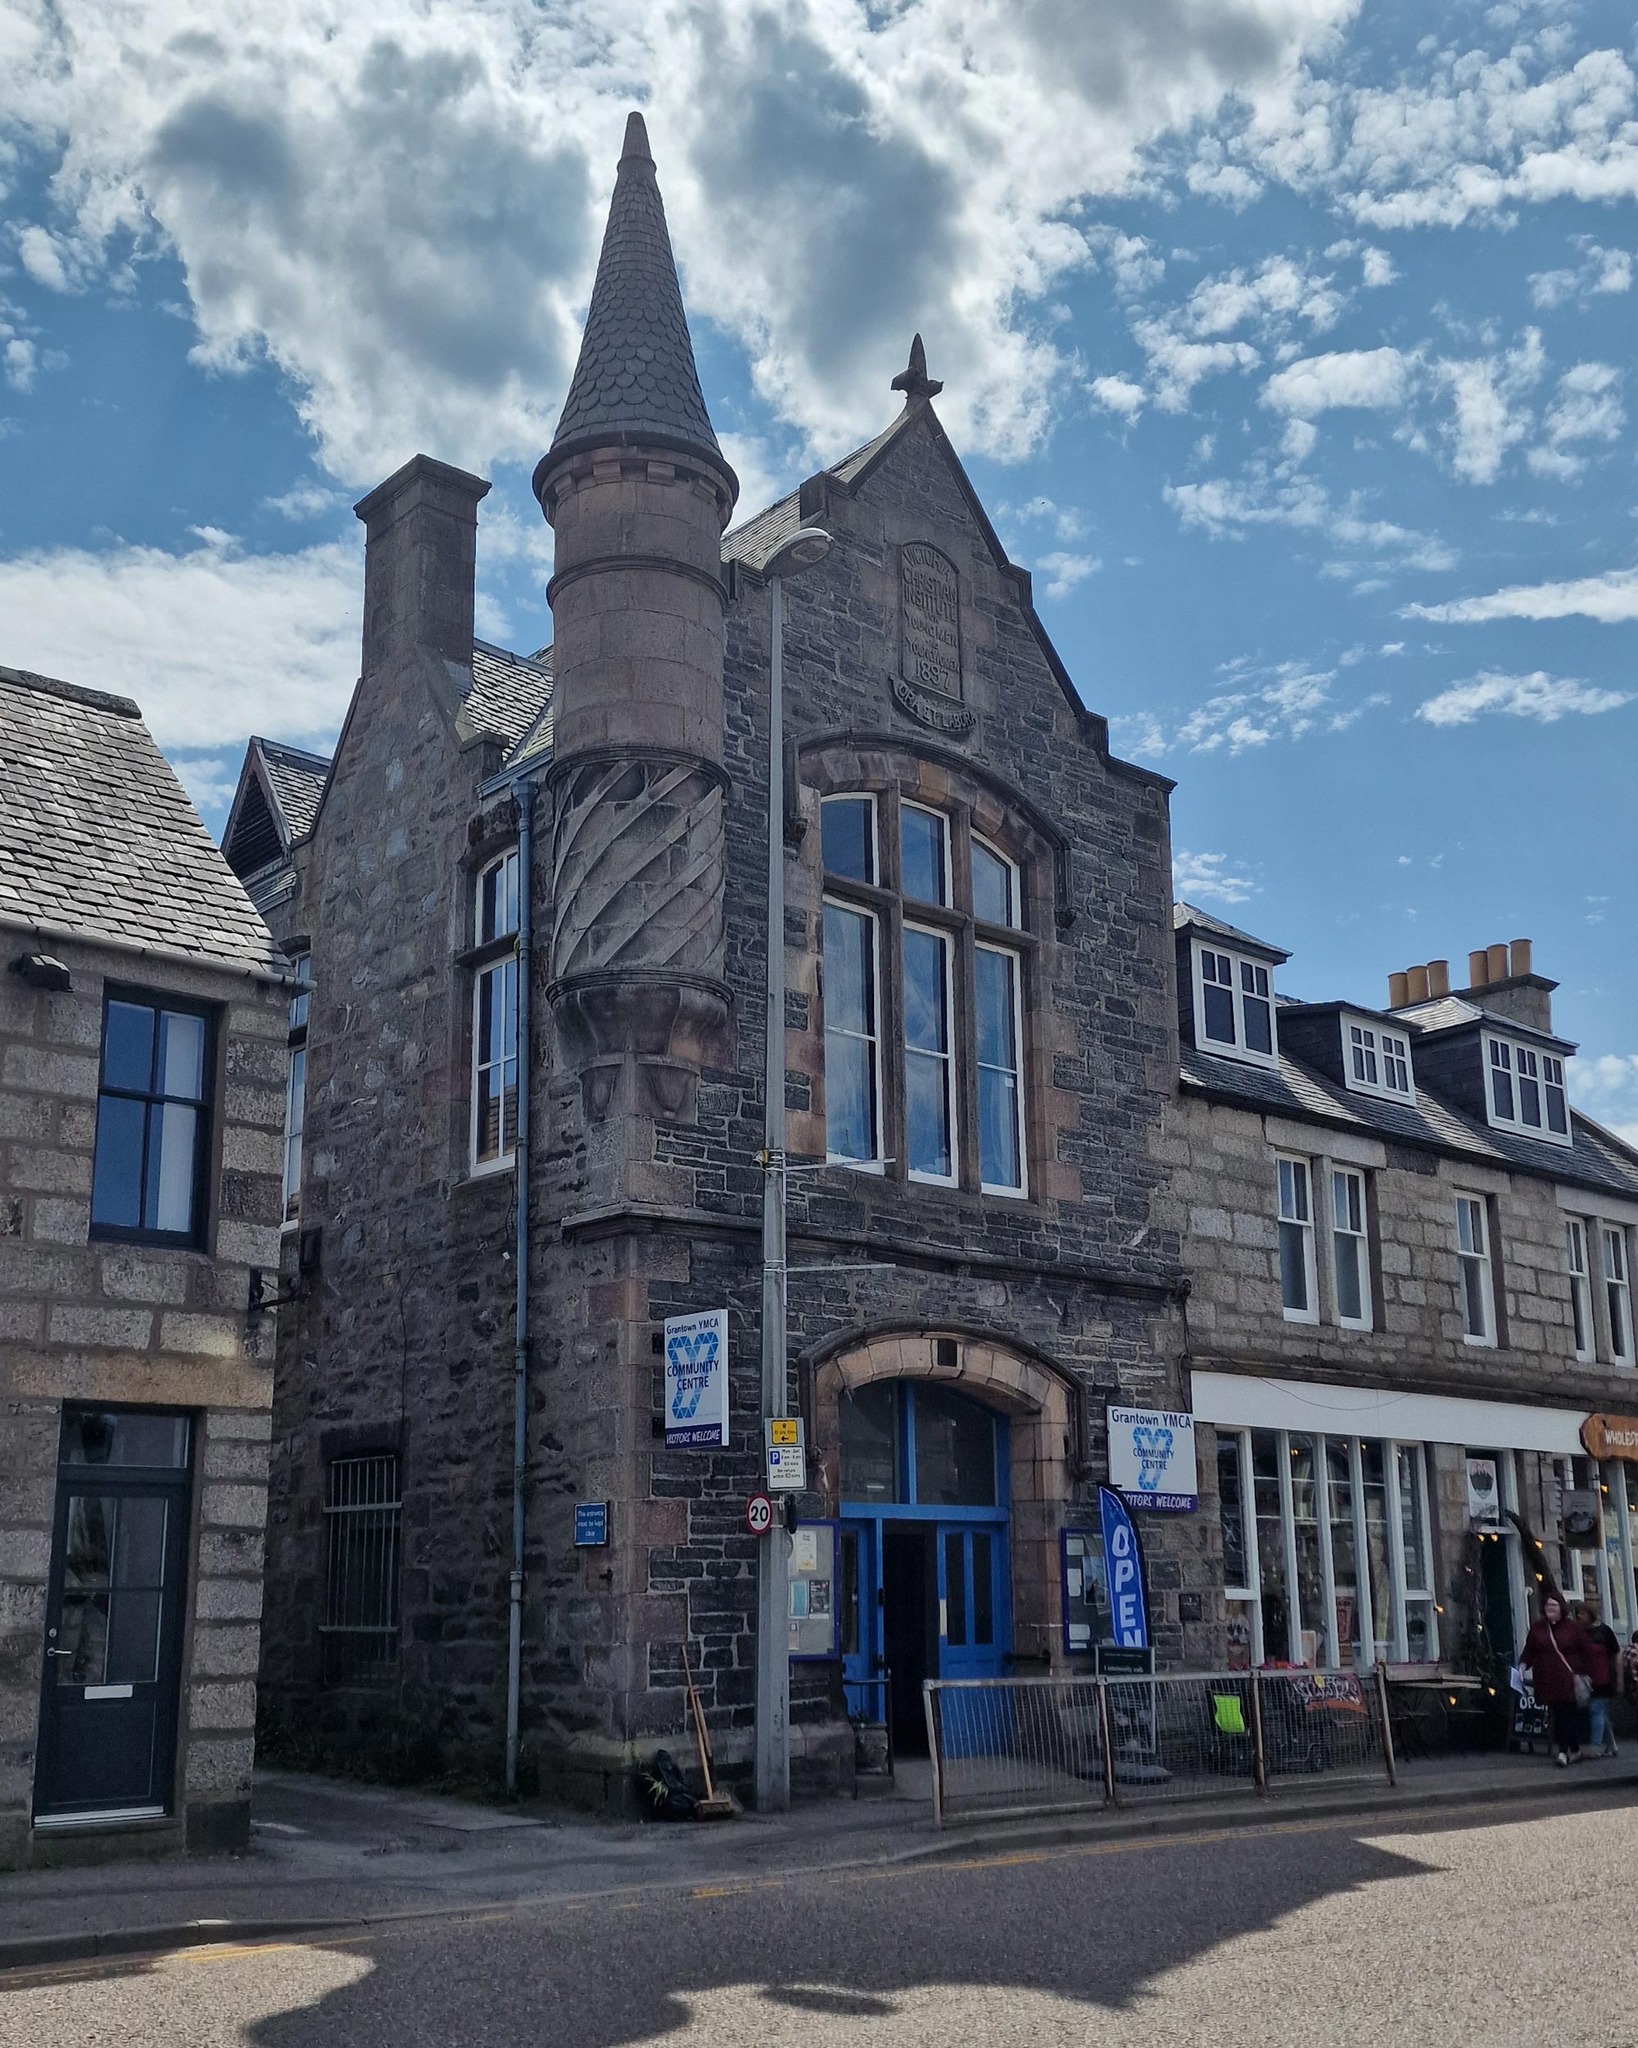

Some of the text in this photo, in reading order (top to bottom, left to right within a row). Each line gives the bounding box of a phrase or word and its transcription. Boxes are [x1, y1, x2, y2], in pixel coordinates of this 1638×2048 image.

[902, 546, 949, 582] VICTORIA
[903, 567, 958, 604] CHRISTIAN
[904, 583, 958, 623] INSTITUTE
[916, 658, 949, 690] 1897
[899, 684, 977, 729] ORA ET LABORA
[666, 1317, 719, 1335] Grantown YMCA
[667, 1359, 720, 1378] COMMUNITY
[676, 1375, 710, 1391] CENTRE
[1111, 1408, 1193, 1430] Grantown YMCA
[666, 1429, 721, 1445] VISITORS WELCOME
[1133, 1447, 1175, 1460] COMMUNITY
[1141, 1460, 1168, 1470] CENTRE
[1155, 1496, 1192, 1509] WELCOME
[750, 1505, 769, 1522] 20
[1112, 1525, 1143, 1648] OPEN
